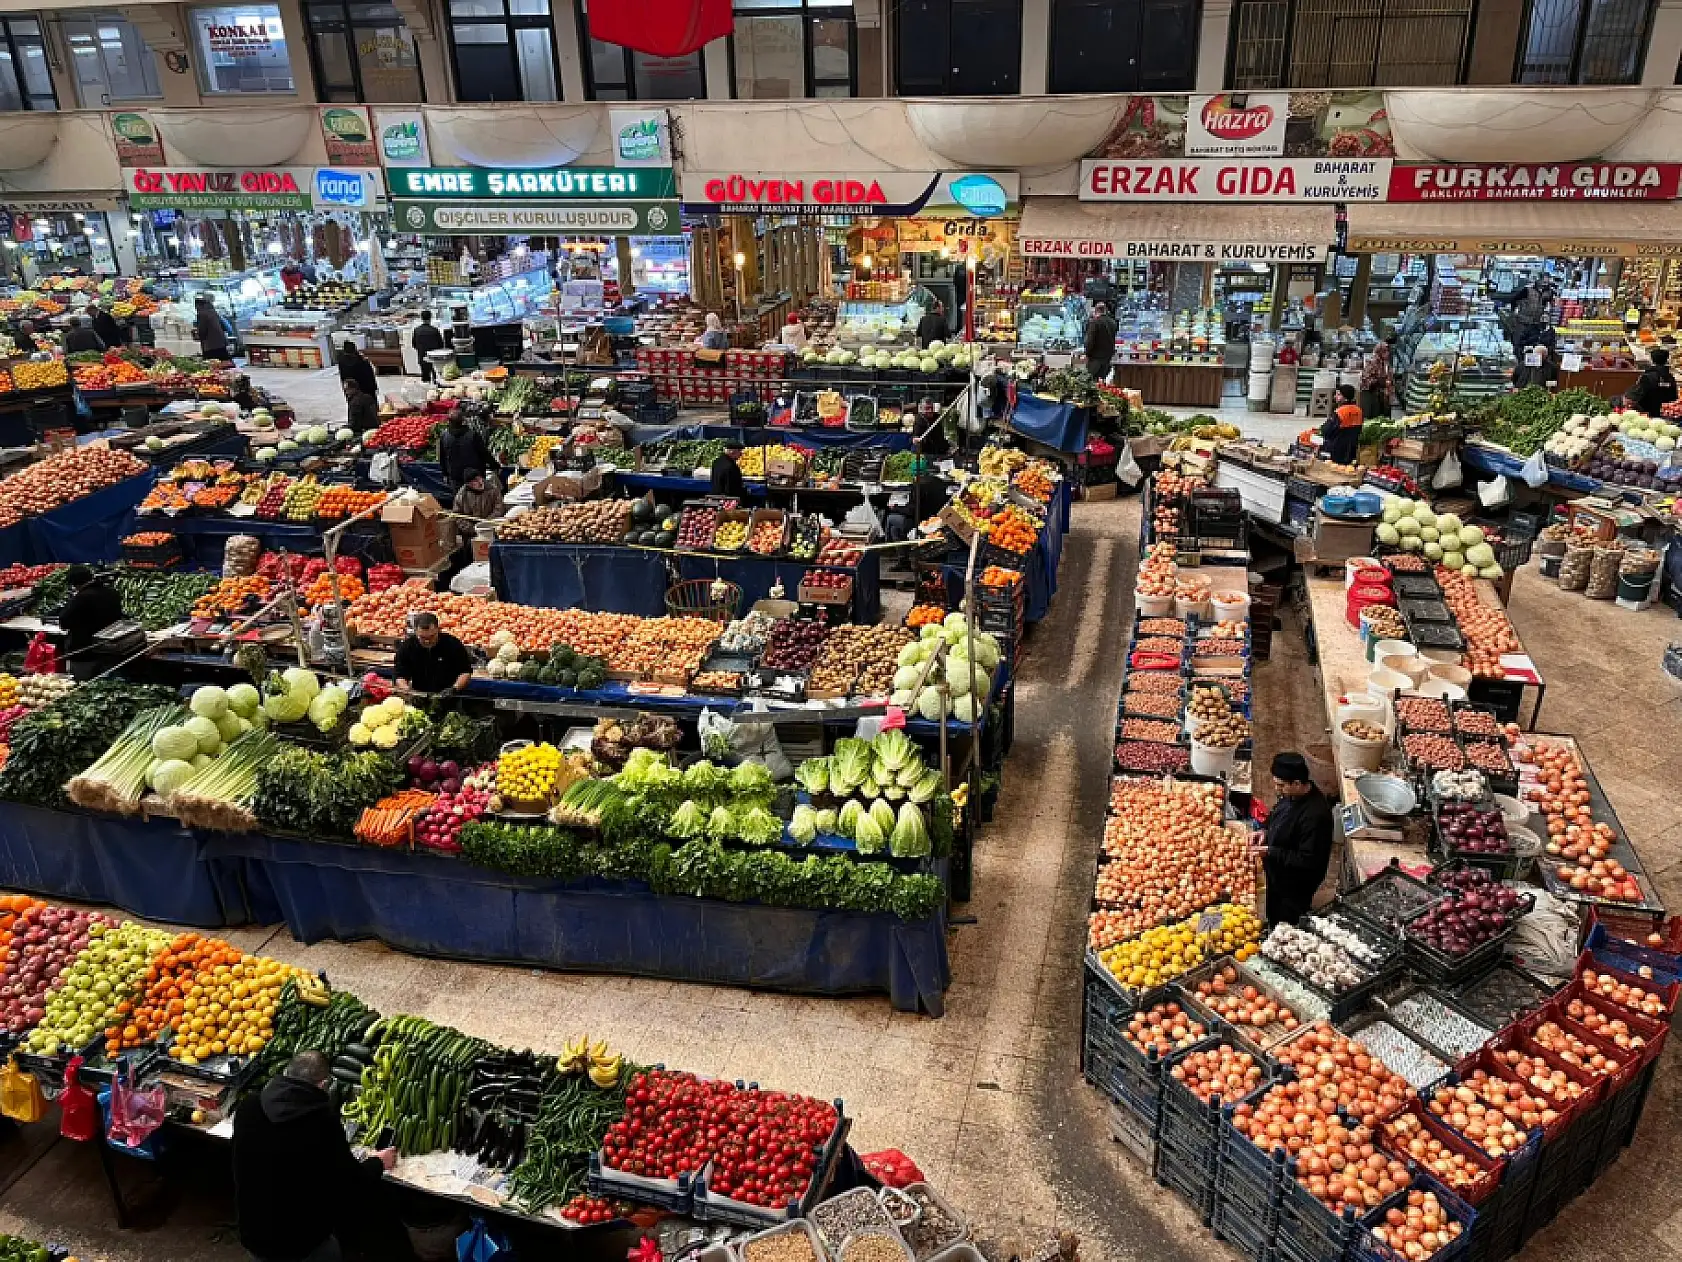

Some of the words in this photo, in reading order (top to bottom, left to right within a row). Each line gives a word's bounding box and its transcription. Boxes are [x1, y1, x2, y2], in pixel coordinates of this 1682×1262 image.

[1205, 110, 1269, 130] Hazra
[1314, 162, 1376, 174] BAHARAT
[1414, 165, 1560, 188] FURKAN
[1571, 166, 1661, 187] GIDA
[134, 168, 164, 193] ÖZ
[166, 172, 238, 193] YAVUZ
[240, 171, 300, 193] GIDA
[406, 172, 474, 192] EMRE
[705, 175, 803, 203] GÜVEN
[812, 179, 888, 203] GIDA
[1090, 166, 1200, 195] ERZAK
[1216, 166, 1297, 196] GIDA
[1337, 175, 1348, 185] &
[1303, 184, 1380, 199] KURUYEMİŞ
[1486, 188, 1545, 198] BAHARAT
[1551, 186, 1577, 198] SÜT
[513, 211, 632, 227] KURULUŞUDUR
[1024, 240, 1073, 255] ERZAK
[1077, 241, 1115, 256] GIDA
[1127, 242, 1199, 258] BAHARAT
[1204, 244, 1217, 258] &
[1221, 242, 1316, 260] KURUYEMİŞ
